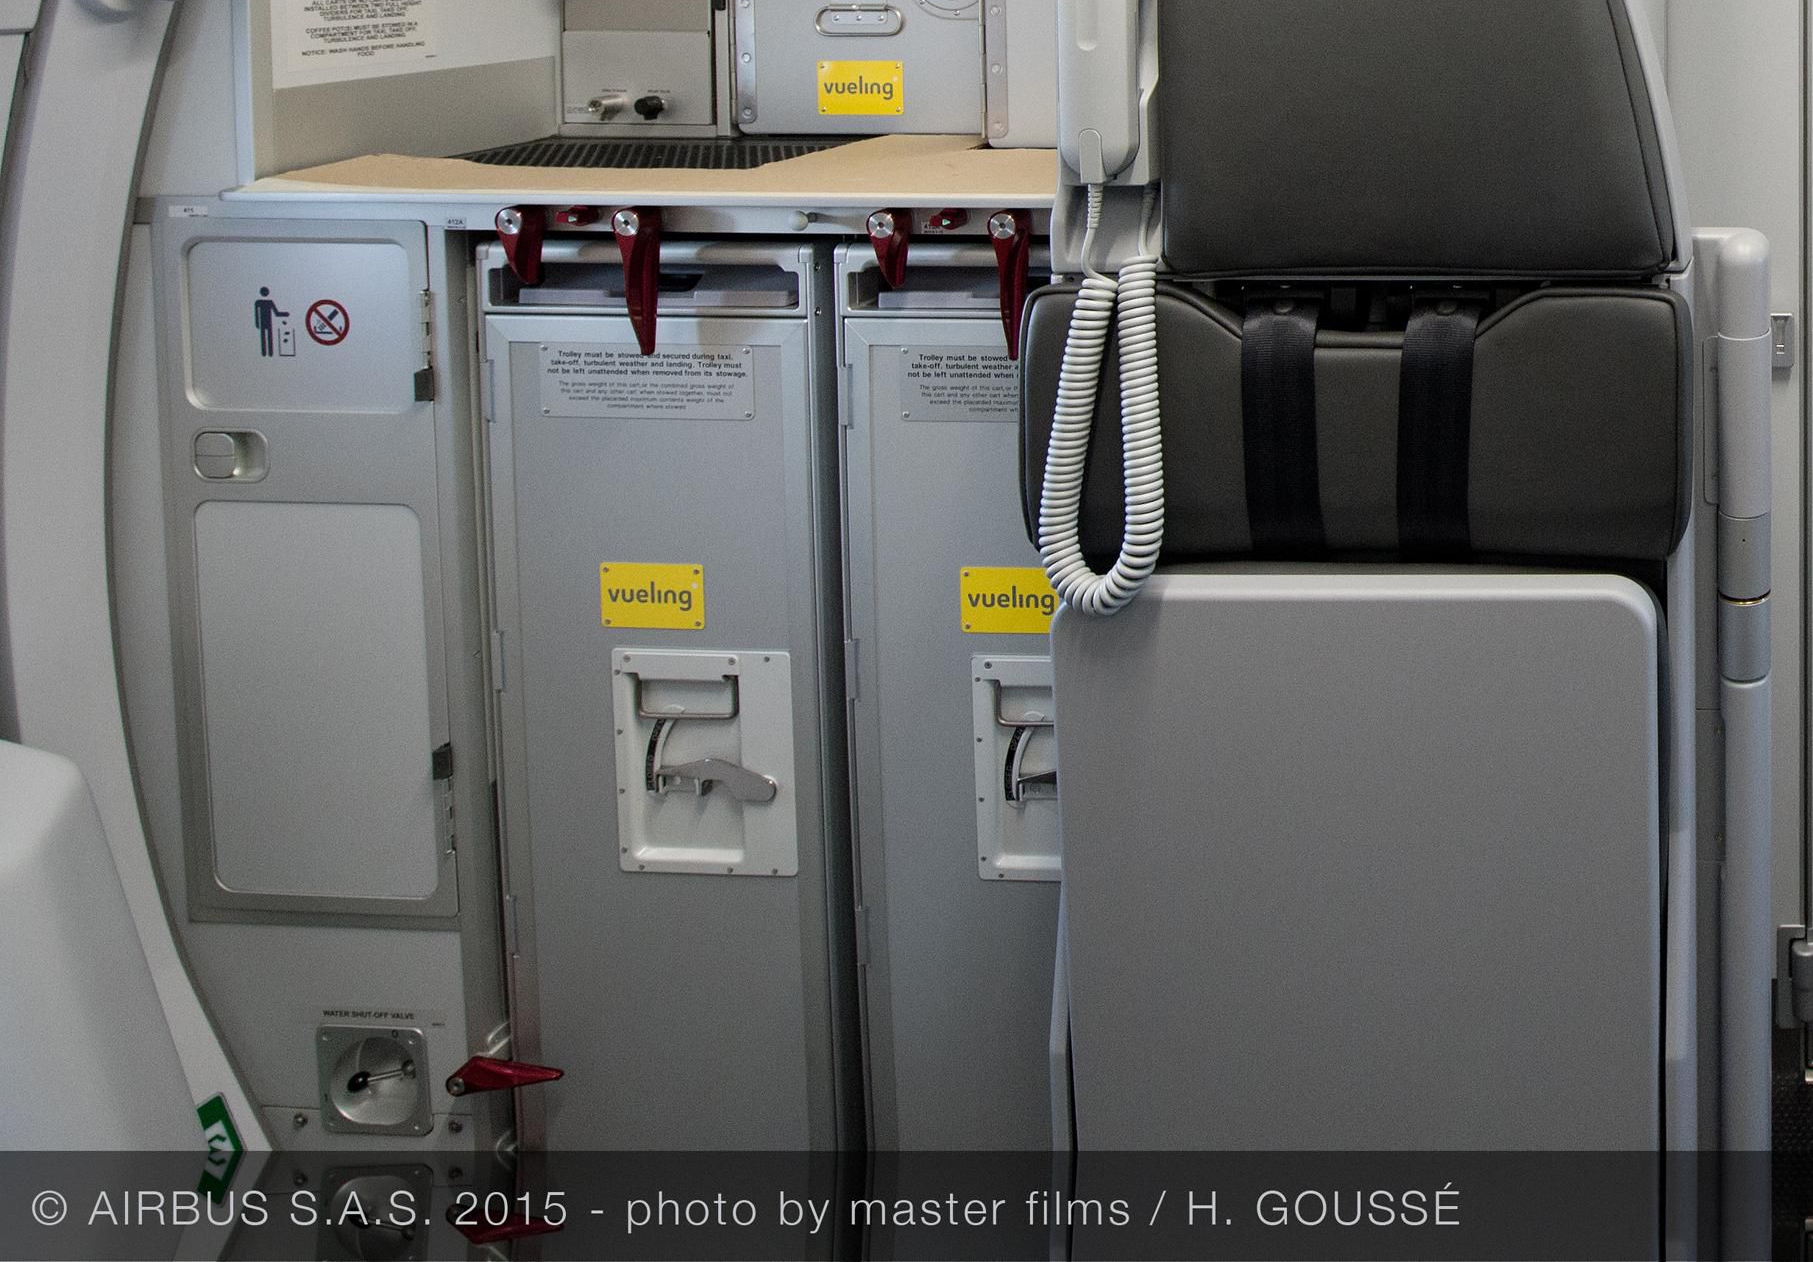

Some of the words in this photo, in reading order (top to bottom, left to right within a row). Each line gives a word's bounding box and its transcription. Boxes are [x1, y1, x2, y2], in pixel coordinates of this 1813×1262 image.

[824, 74, 895, 100] vueling
[558, 350, 582, 359] Trolley
[692, 352, 715, 361] during
[920, 354, 944, 362] Trolley
[666, 361, 695, 369] landing.
[698, 362, 722, 370] Trolley
[608, 582, 693, 613] vueling
[968, 586, 1056, 617] vueling
[323, 1010, 350, 1018] WATER
[352, 1010, 388, 1019] SHUT-OFF
